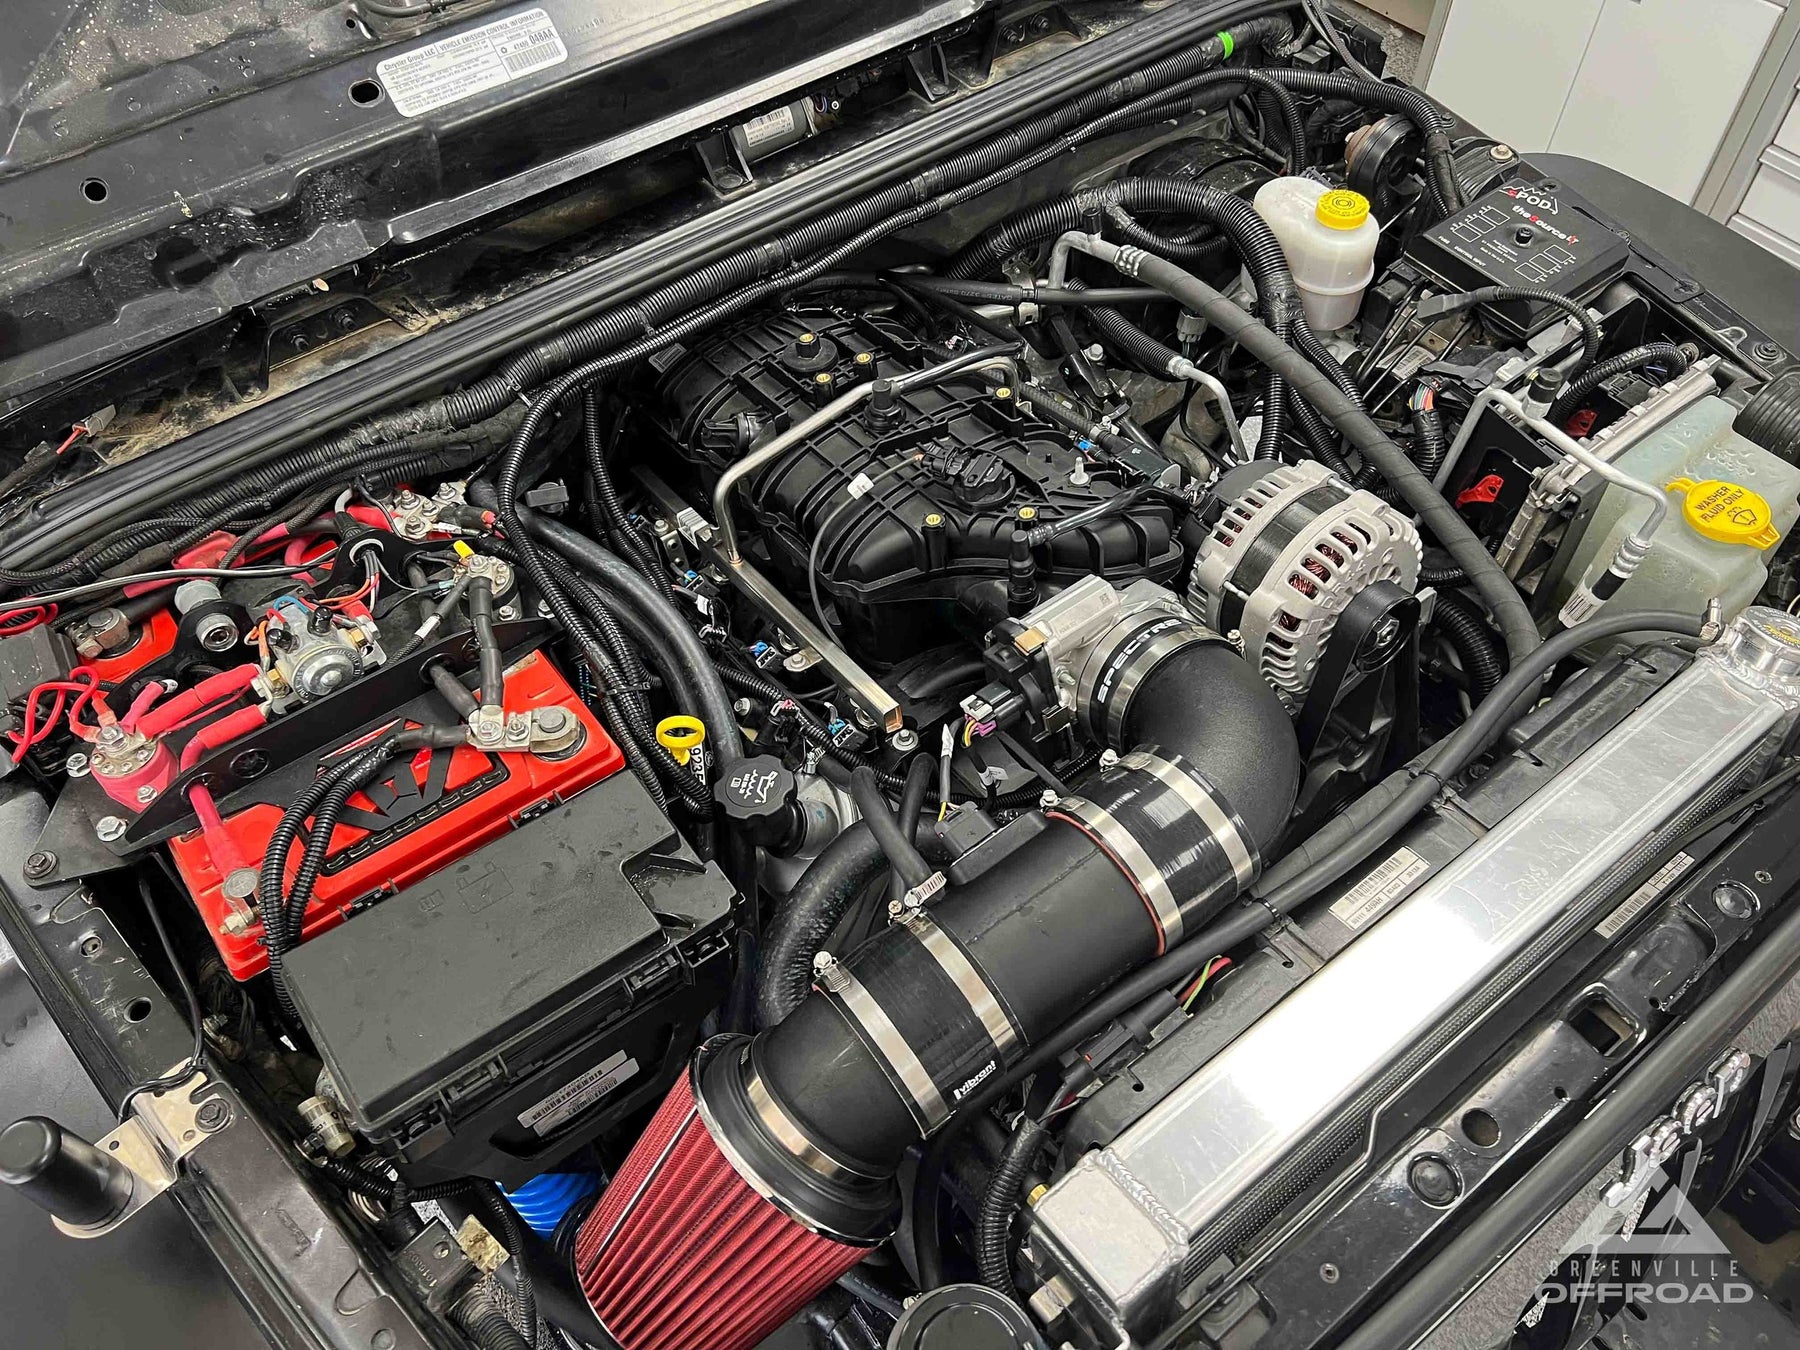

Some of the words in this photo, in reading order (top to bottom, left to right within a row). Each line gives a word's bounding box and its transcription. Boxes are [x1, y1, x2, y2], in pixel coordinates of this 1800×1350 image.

[407, 53, 425, 63] Group
[424, 48, 437, 57] LLC
[439, 38, 463, 52] VEHICLE
[461, 30, 487, 44] EMISSION
[486, 22, 509, 36] CONTROL
[509, 11, 545, 27] INFORMATION
[1695, 486, 1731, 511] WASHER
[1700, 503, 1725, 522] FLUID
[1723, 488, 1744, 505] ONLY
[1097, 618, 1182, 703] SPECTRE
[959, 1060, 997, 1092] vibrant
